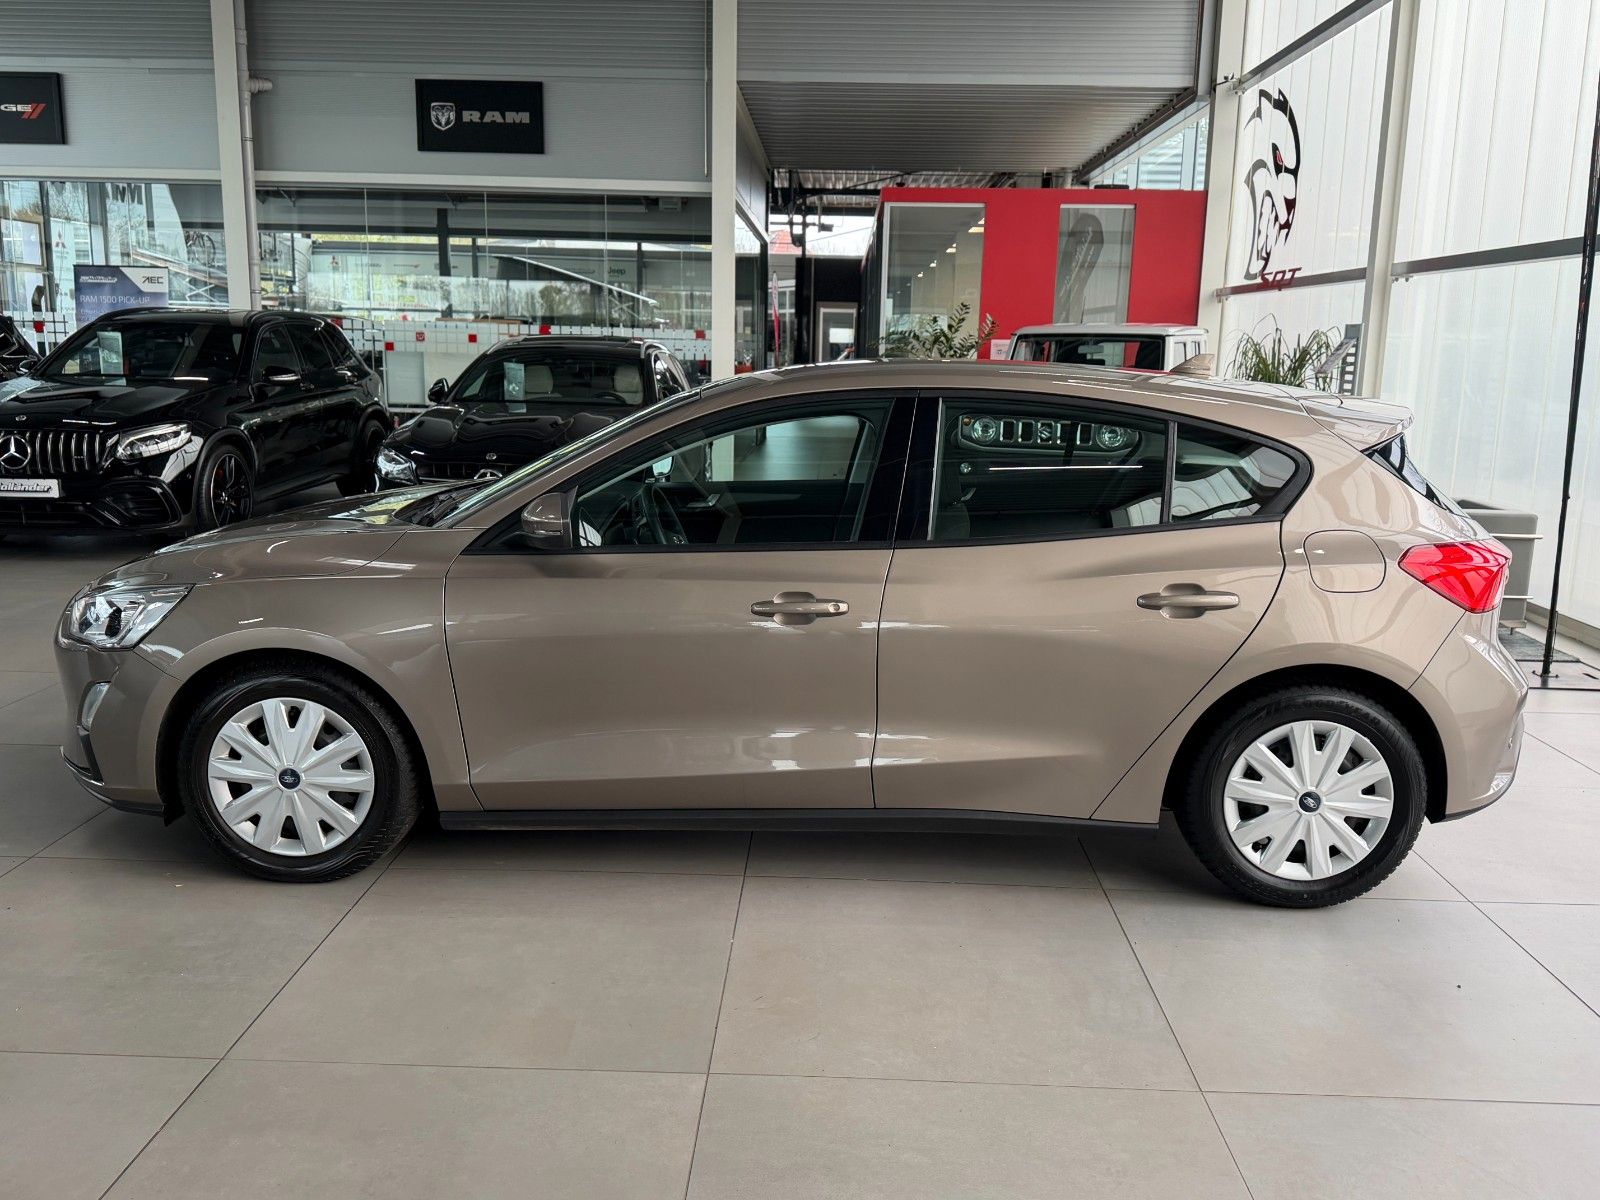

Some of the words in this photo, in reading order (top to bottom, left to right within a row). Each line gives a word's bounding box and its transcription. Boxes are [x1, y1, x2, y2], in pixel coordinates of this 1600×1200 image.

[462, 110, 530, 124] RAM
[142, 276, 164, 284] AEC
[79, 295, 98, 303] RAM
[99, 295, 117, 304] 1500
[118, 296, 150, 304] PICK-UP
